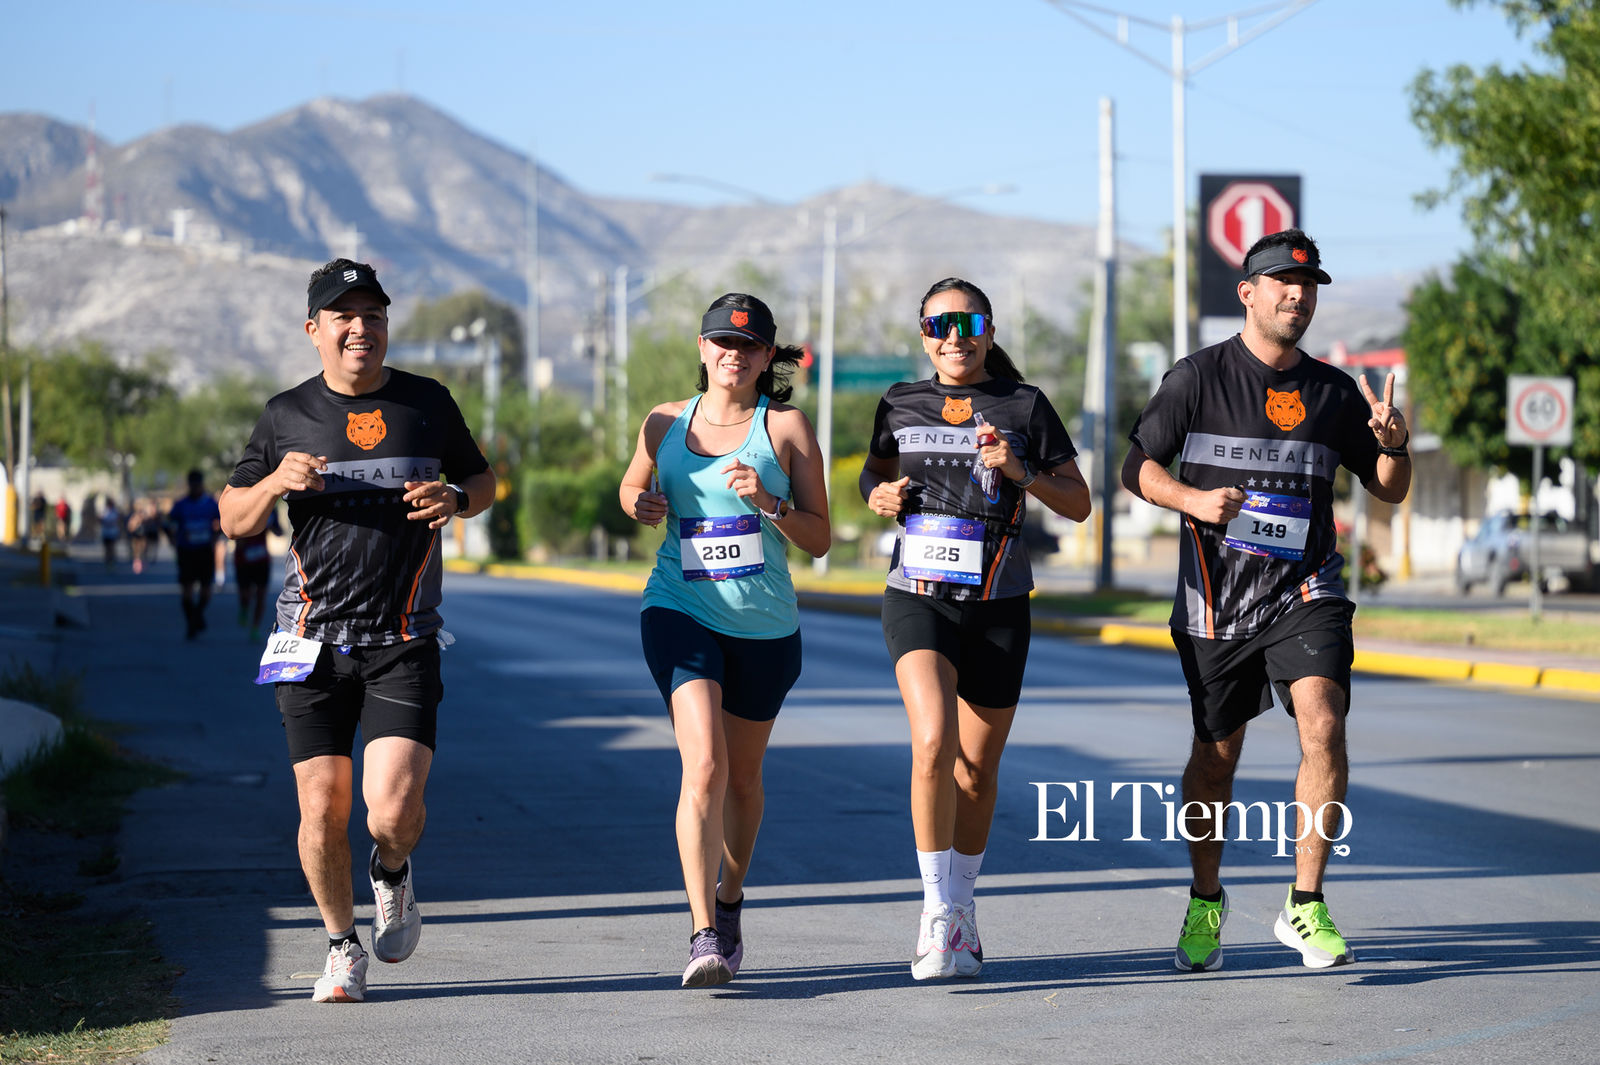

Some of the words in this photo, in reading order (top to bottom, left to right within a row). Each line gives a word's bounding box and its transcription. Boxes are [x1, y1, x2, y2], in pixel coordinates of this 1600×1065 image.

[898, 433, 972, 445] BENGA
[331, 466, 433, 483] NGALAS
[1251, 520, 1287, 539] 149
[702, 544, 741, 561] 230
[923, 545, 960, 562] 225
[273, 639, 301, 655] 277
